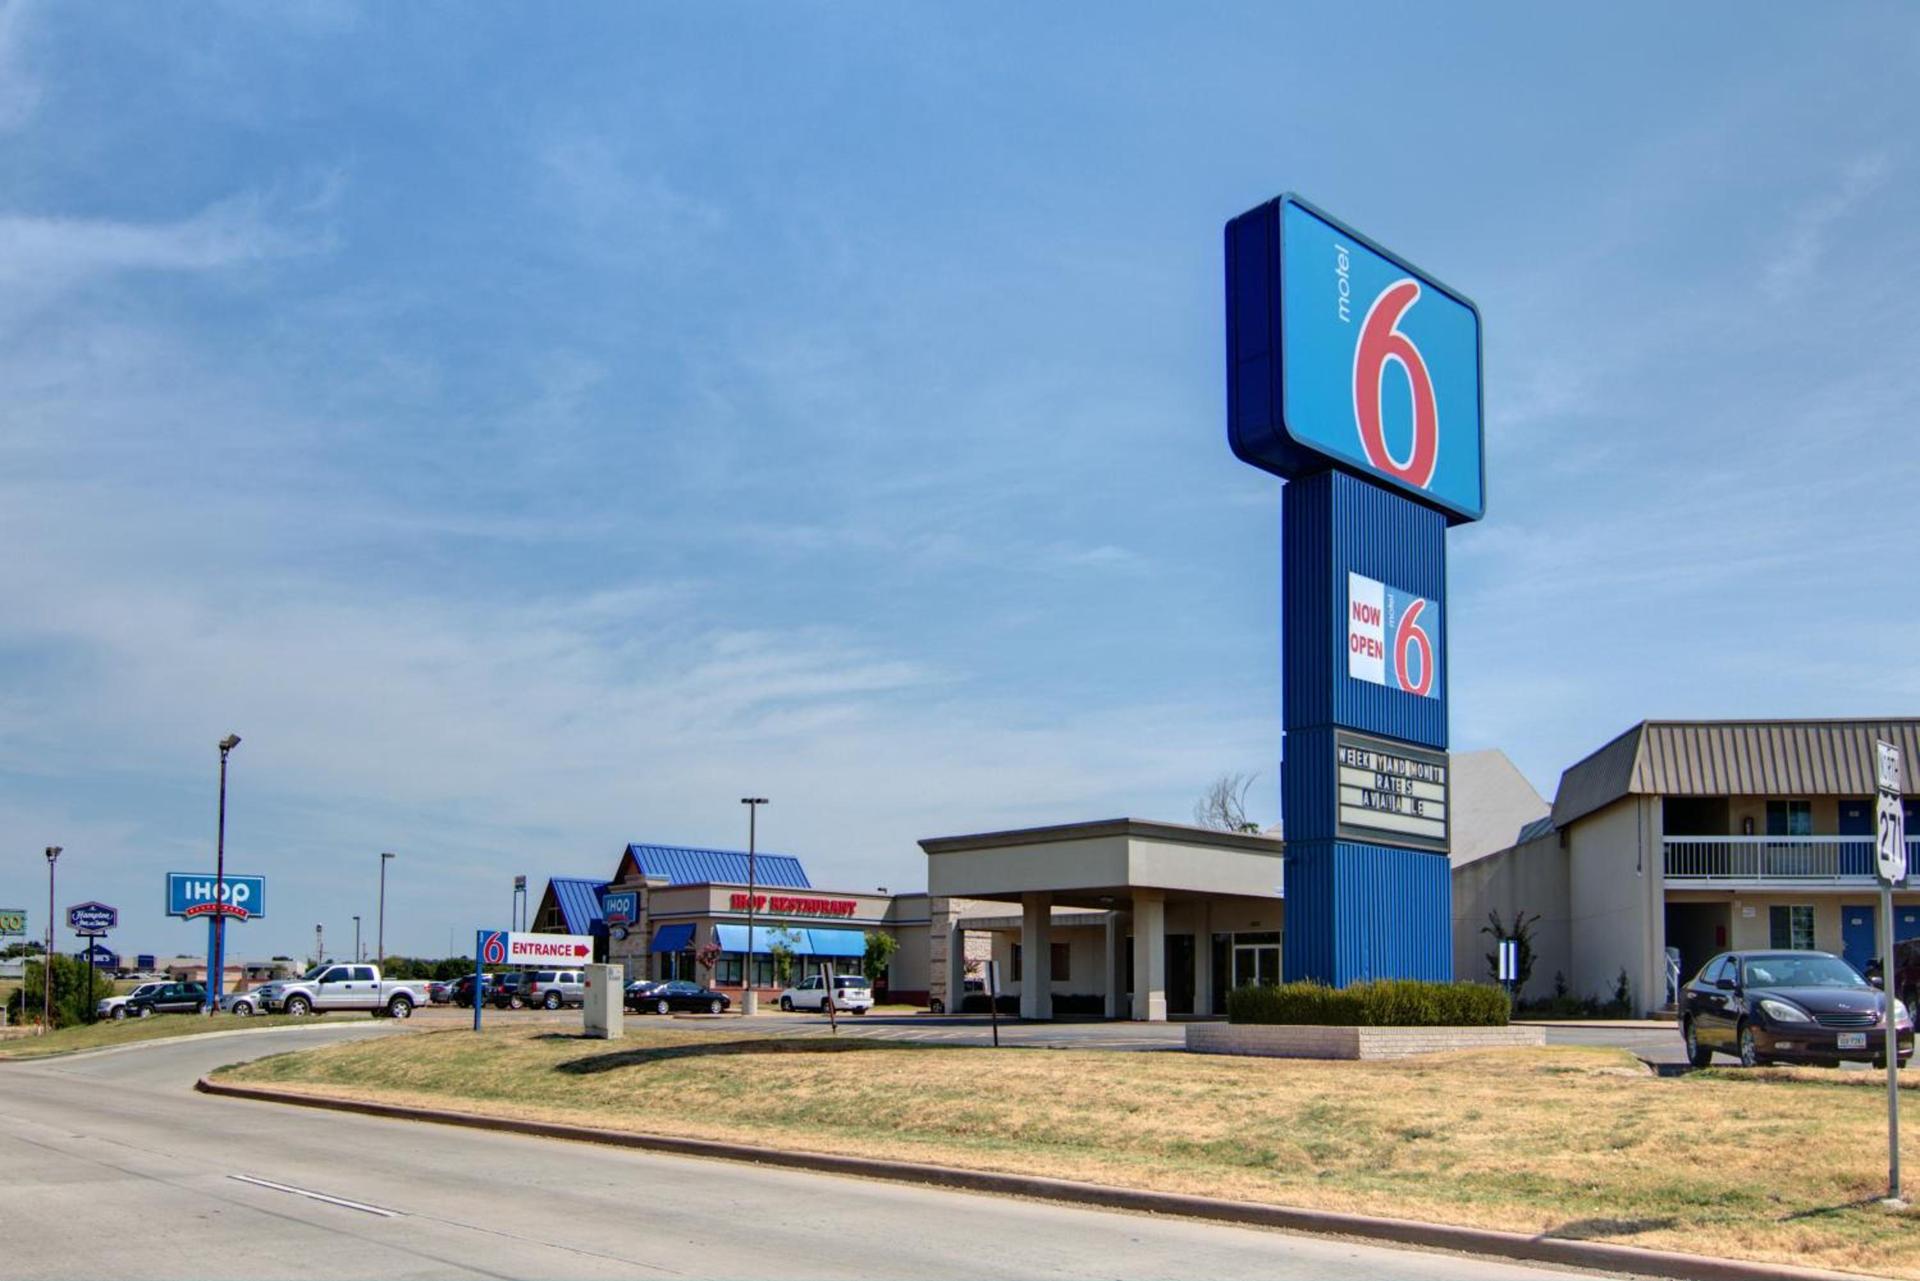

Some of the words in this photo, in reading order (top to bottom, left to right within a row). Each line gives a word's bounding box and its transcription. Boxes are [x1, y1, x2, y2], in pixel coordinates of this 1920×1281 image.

[1334, 243, 1350, 323] motel
[1352, 278, 1439, 489] 6
[1352, 601, 1381, 627] NOW
[1350, 633, 1383, 660] OPEN
[1394, 598, 1434, 697] 6
[1377, 774, 1413, 794] RATES
[769, 896, 857, 916] RESTAURANT
[483, 931, 505, 964] 6
[512, 942, 572, 956] ENTRANCE
